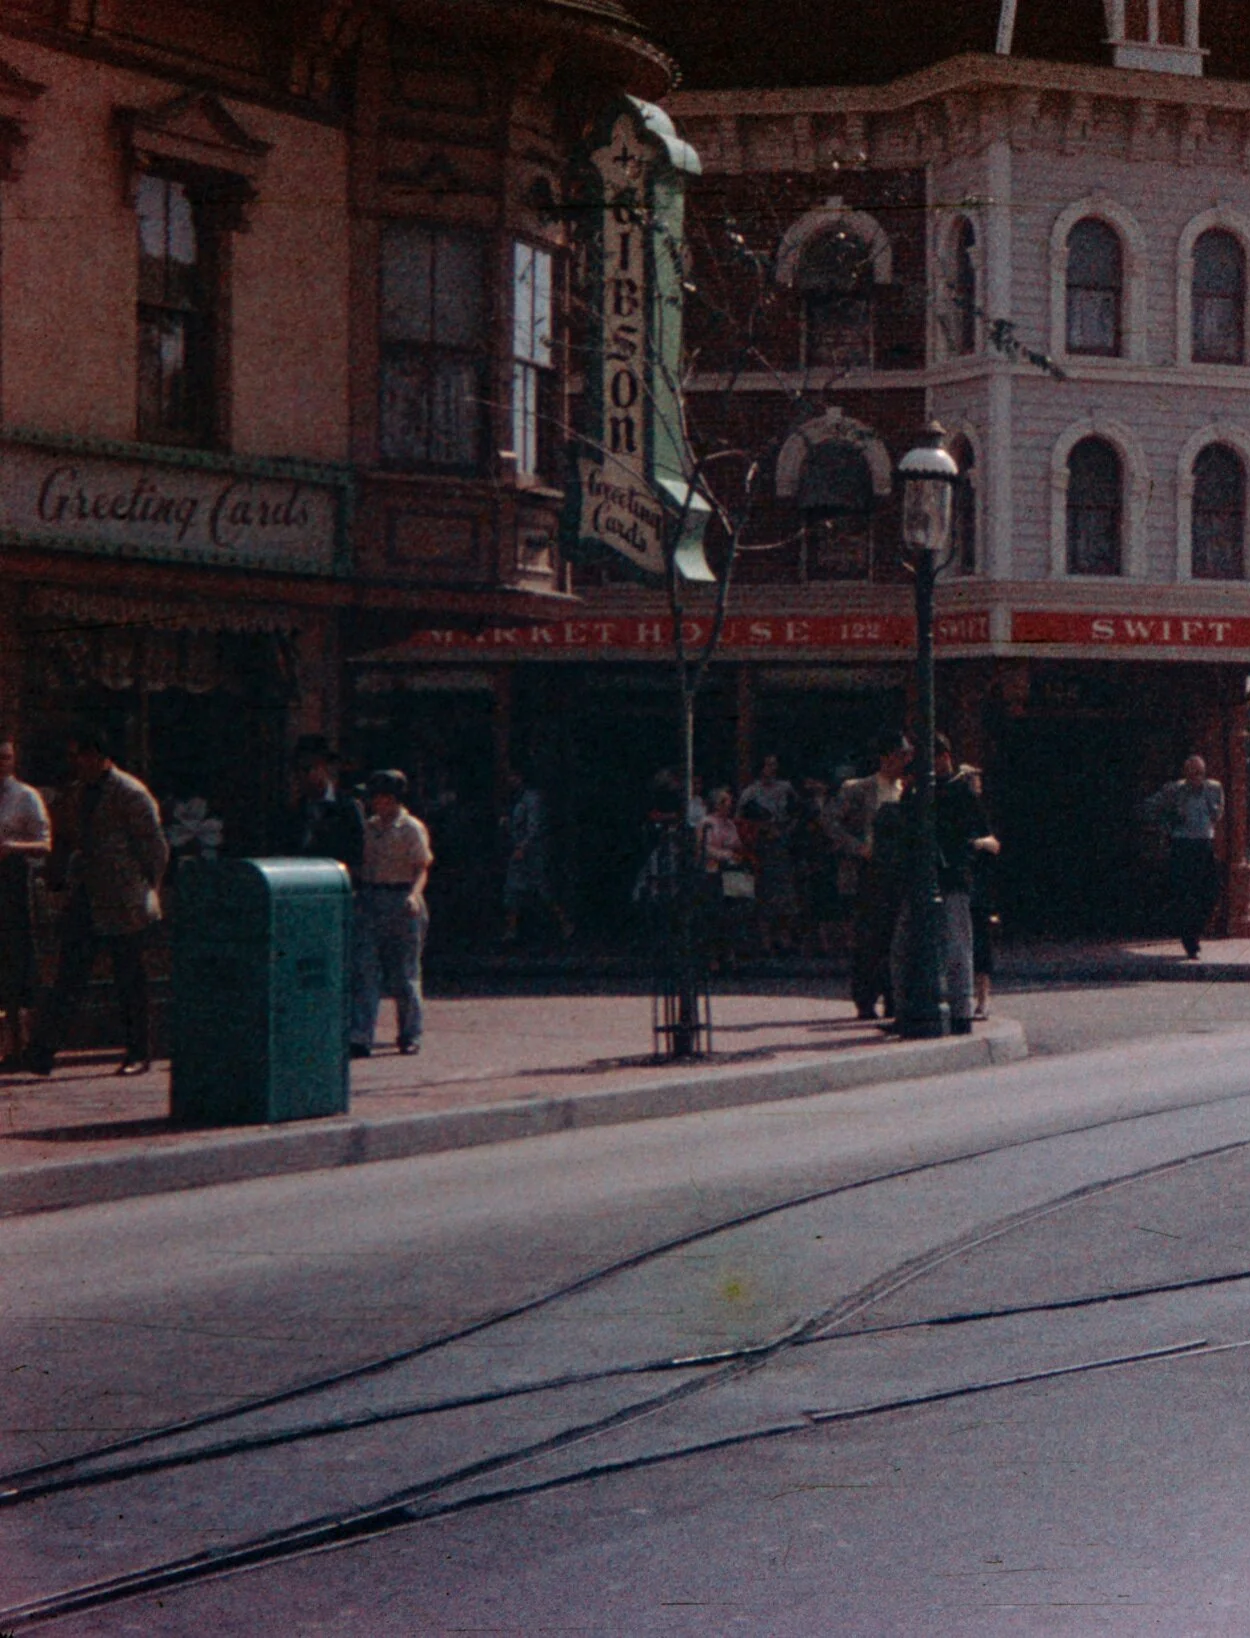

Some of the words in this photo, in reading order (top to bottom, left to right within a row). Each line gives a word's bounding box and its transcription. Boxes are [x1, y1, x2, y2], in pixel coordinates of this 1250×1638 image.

[37, 465, 199, 543] Greeting
[208, 481, 311, 547] Cards
[588, 468, 663, 542] Greeting
[592, 502, 648, 553] Cards
[429, 621, 618, 644] MRKET
[840, 622, 880, 641] 122
[938, 617, 988, 641] SWIFT
[1090, 618, 1233, 643] SWIFT
